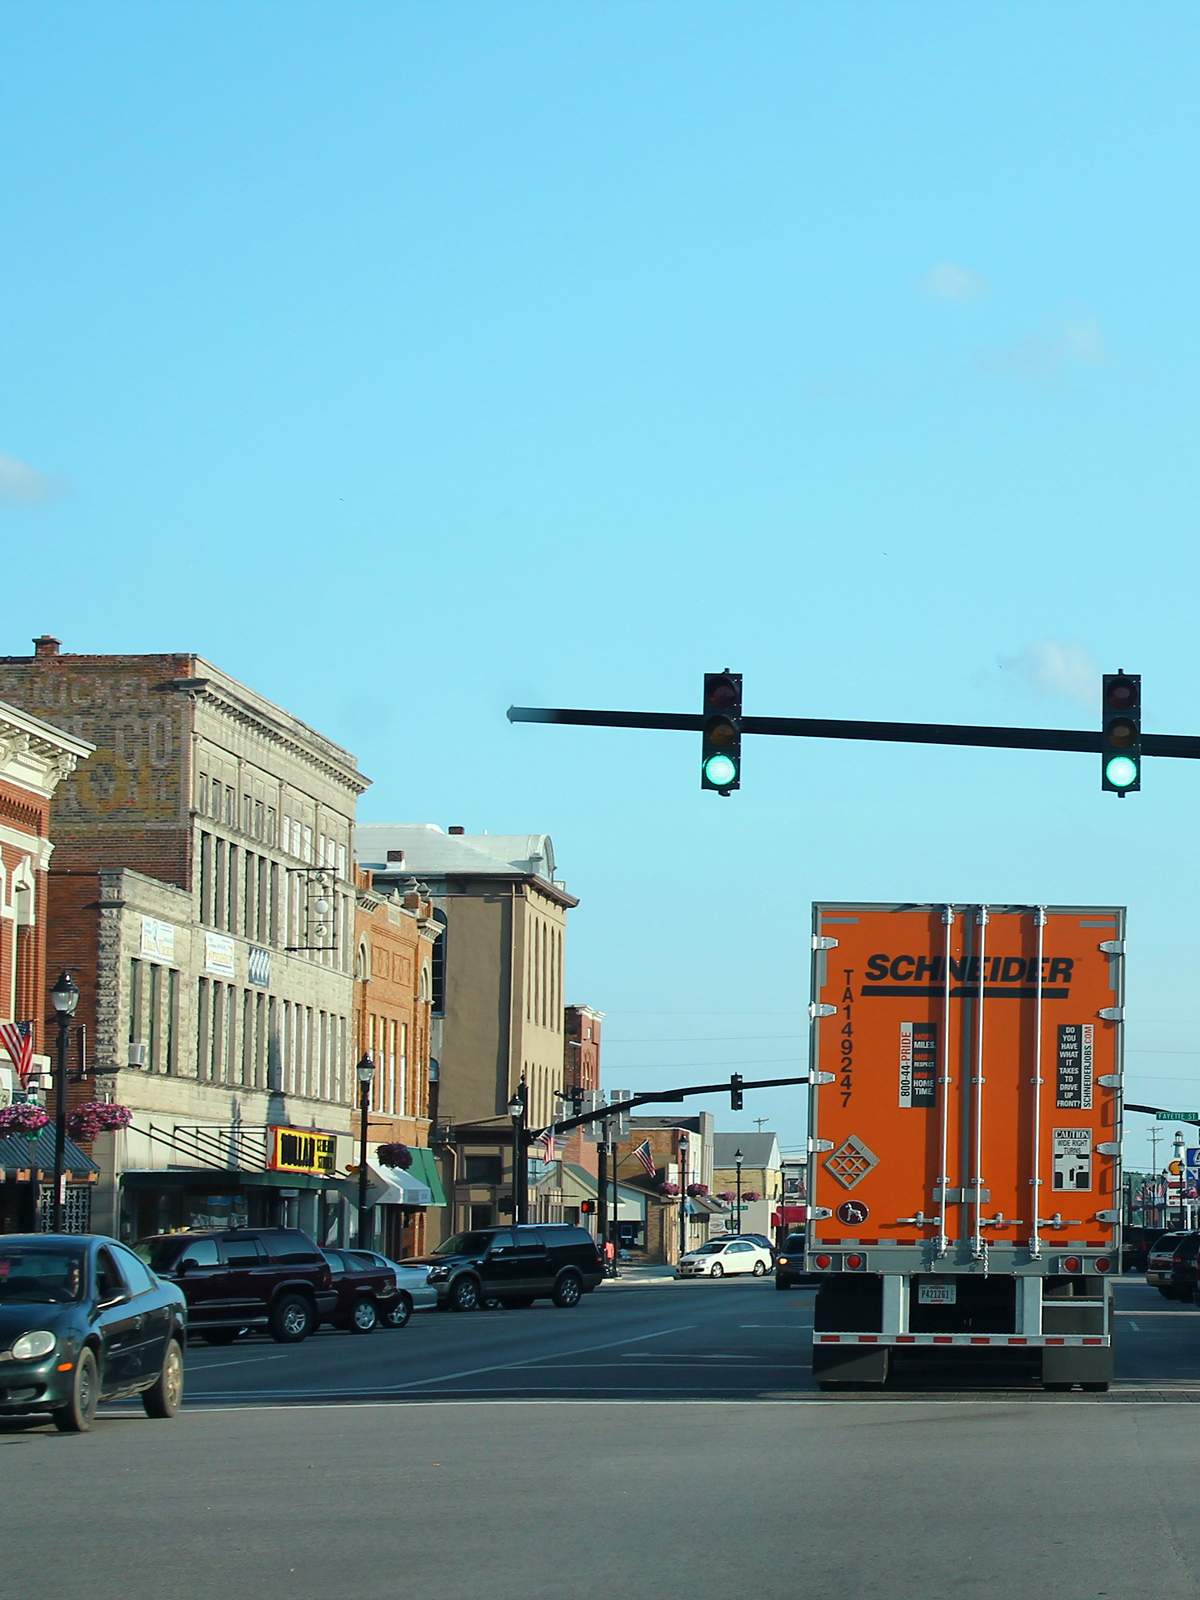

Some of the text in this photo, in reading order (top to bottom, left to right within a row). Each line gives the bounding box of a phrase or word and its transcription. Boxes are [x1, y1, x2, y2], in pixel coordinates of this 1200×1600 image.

[864, 953, 1075, 983] SCHNEIDER
[1065, 1026, 1075, 1034] DO
[1062, 1034, 1076, 1042] YOU
[914, 1041, 936, 1049] MILES.
[900, 1032, 911, 1097] 800-44-PRIDE
[1083, 1026, 1092, 1108] SCHNEIDERJOBS.COM
[1064, 1075, 1074, 1083] TO
[1059, 1083, 1078, 1091] DRIVE
[1064, 1091, 1074, 1099] UP
[1056, 1100, 1080, 1108] FRONT?
[1055, 1130, 1089, 1139] CAUTION
